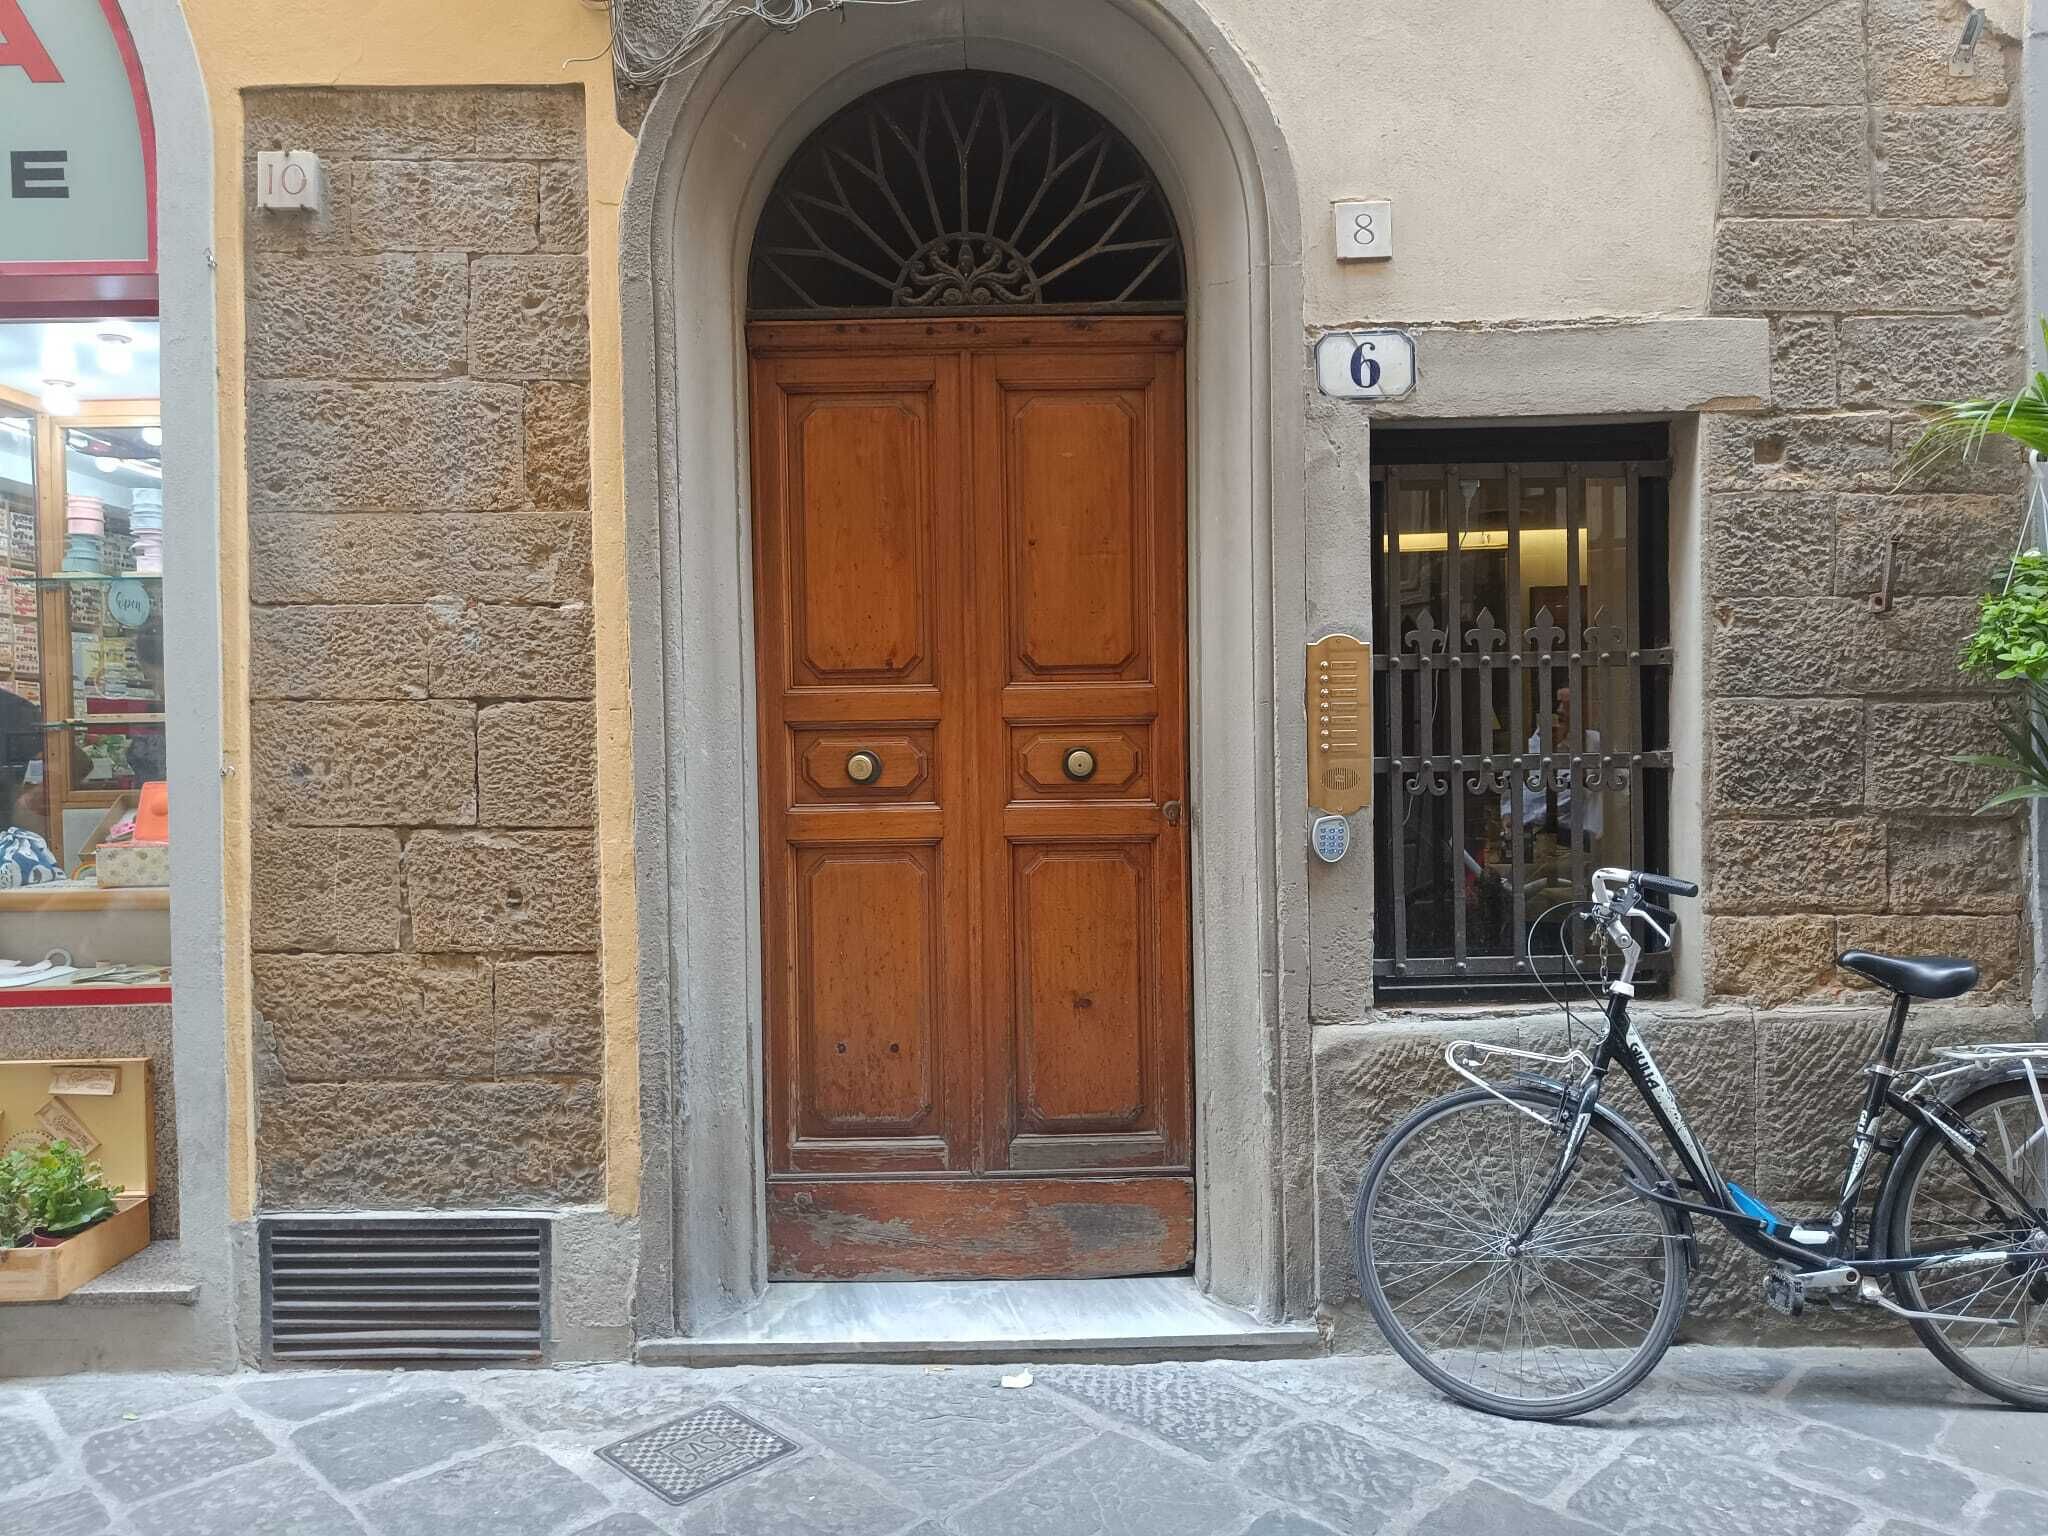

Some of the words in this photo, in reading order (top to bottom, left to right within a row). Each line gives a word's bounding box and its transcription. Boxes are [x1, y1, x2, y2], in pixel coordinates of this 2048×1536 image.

[10, 150, 70, 199] E
[266, 163, 307, 195] 10
[1353, 213, 1375, 245] 8
[1350, 342, 1381, 388] 6
[668, 1434, 727, 1465] GAS
